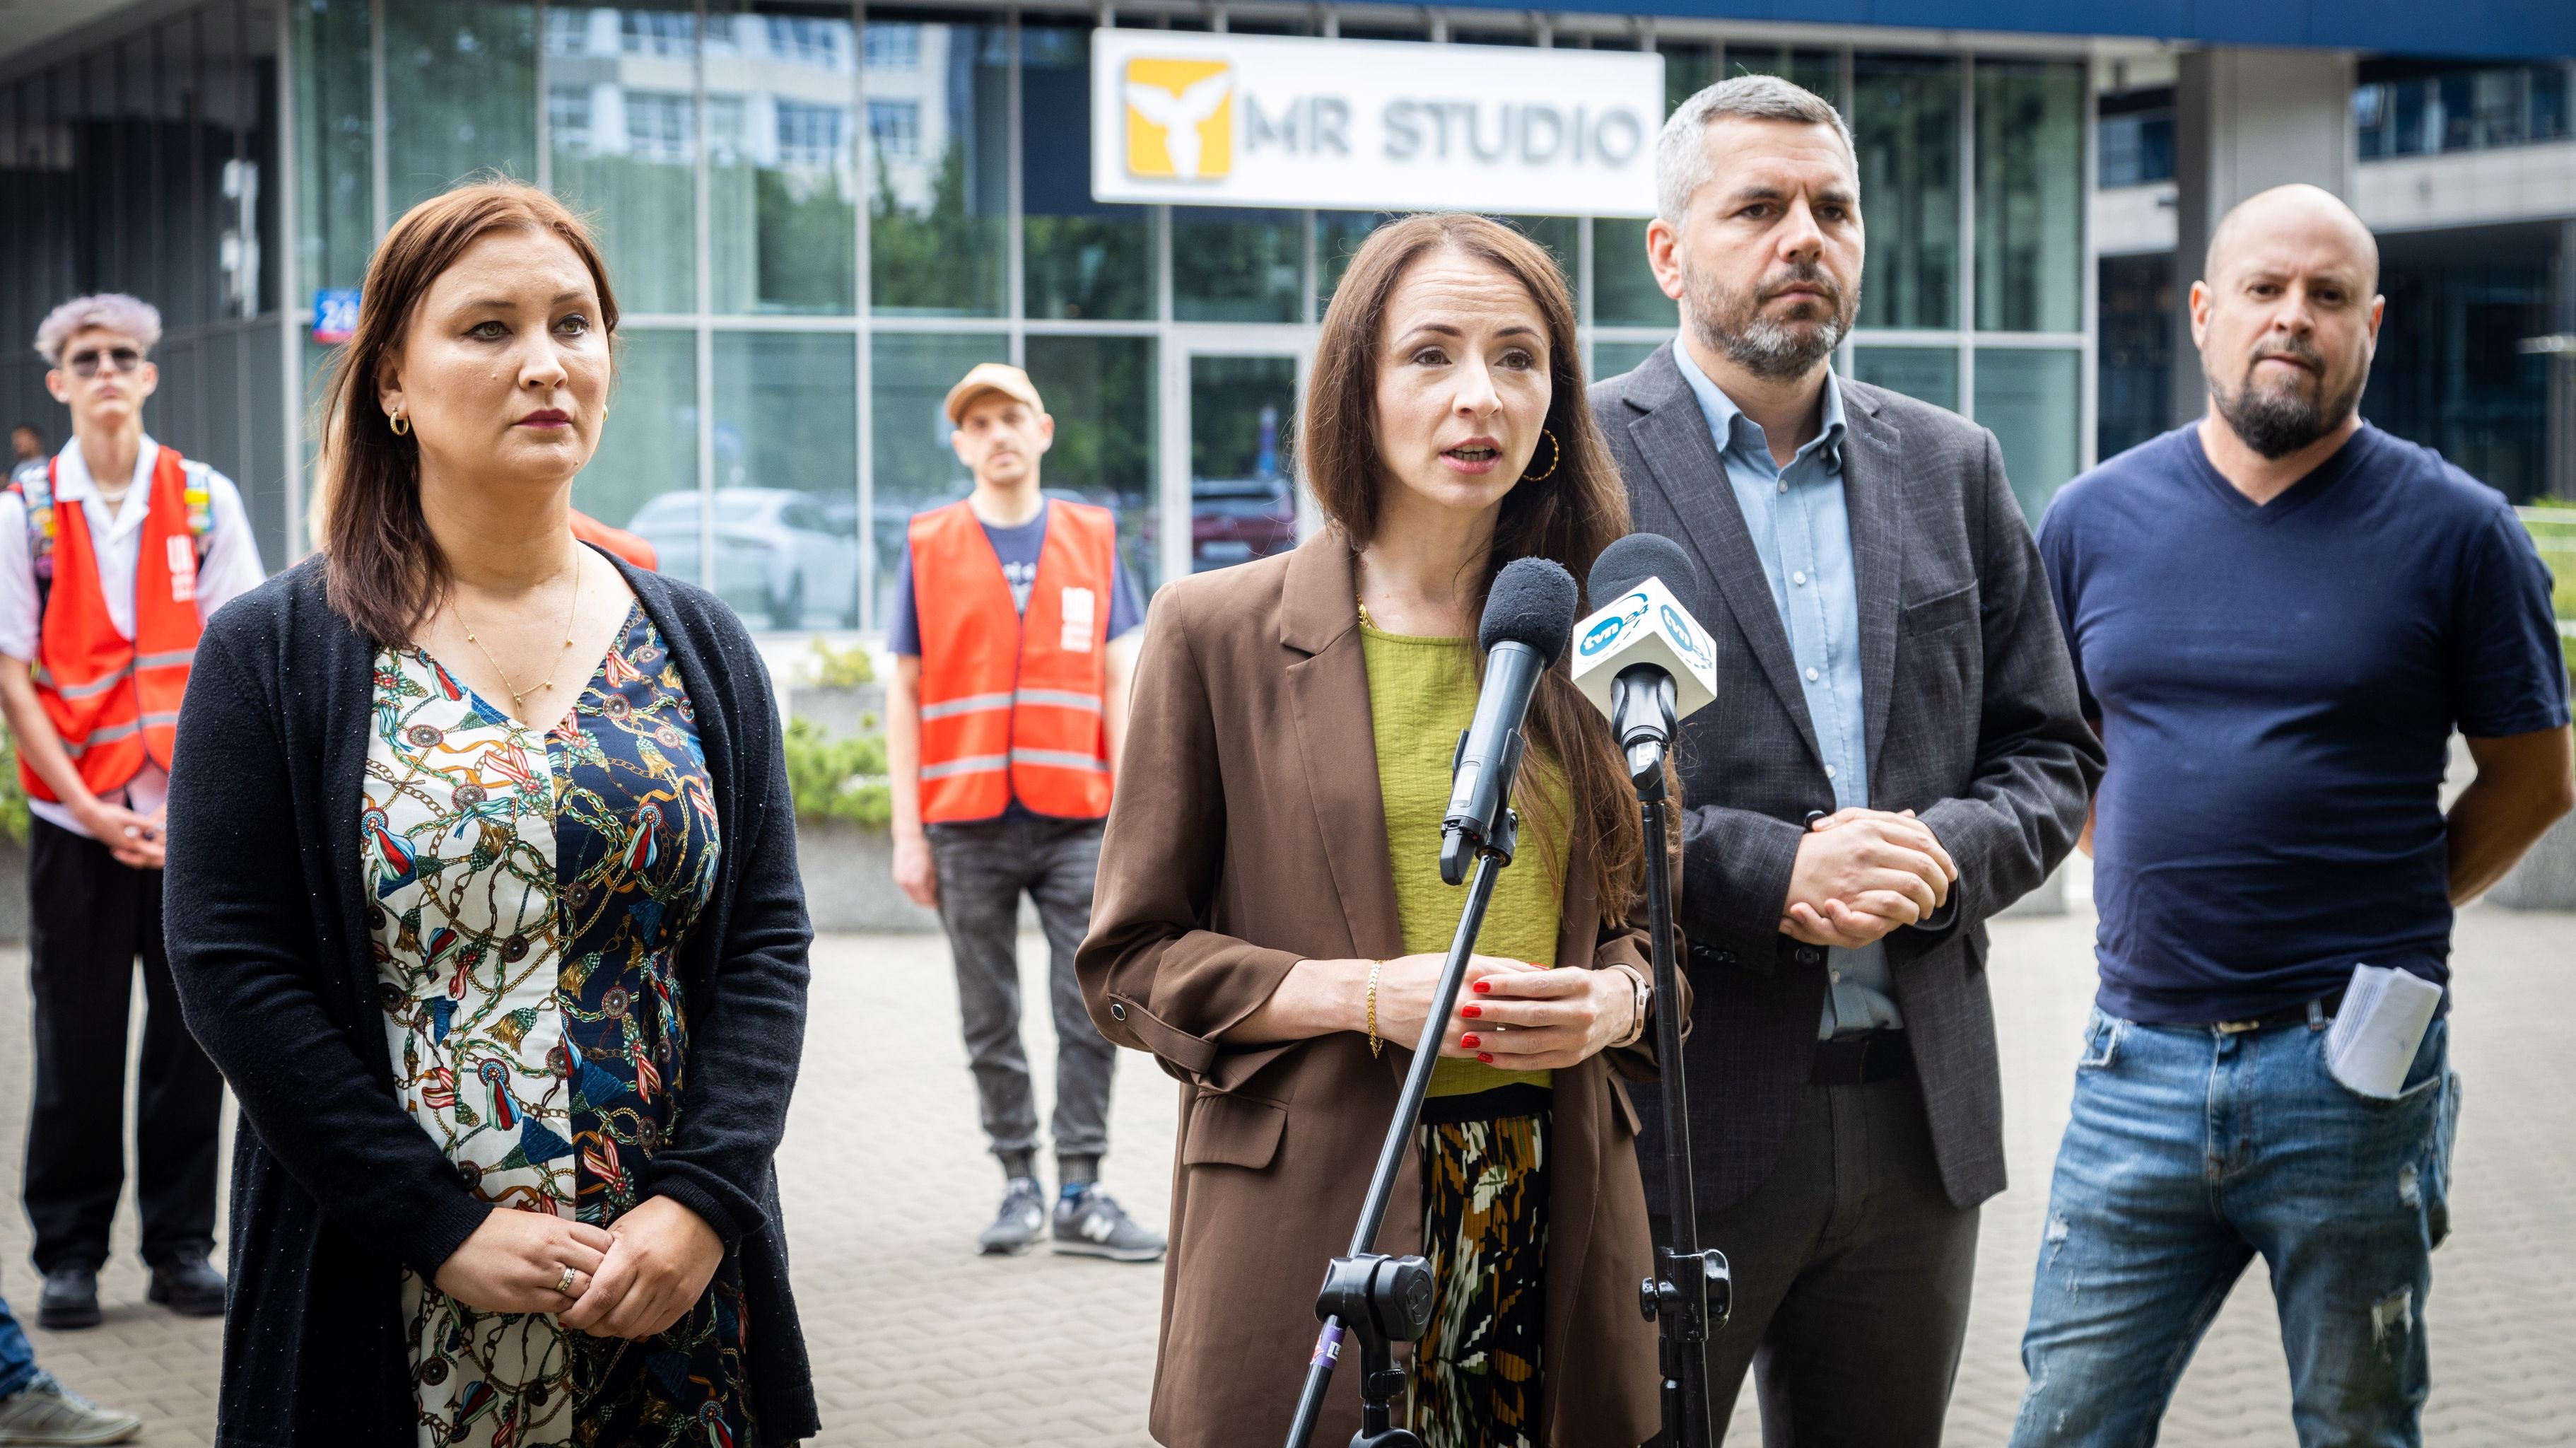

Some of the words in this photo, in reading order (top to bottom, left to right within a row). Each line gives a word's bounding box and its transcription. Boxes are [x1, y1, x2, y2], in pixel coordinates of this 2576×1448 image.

[1243, 93, 1352, 157] MR
[1381, 98, 1643, 168] STUDIO
[1583, 621, 1619, 650] tvn
[1663, 608, 1690, 648] tvn
